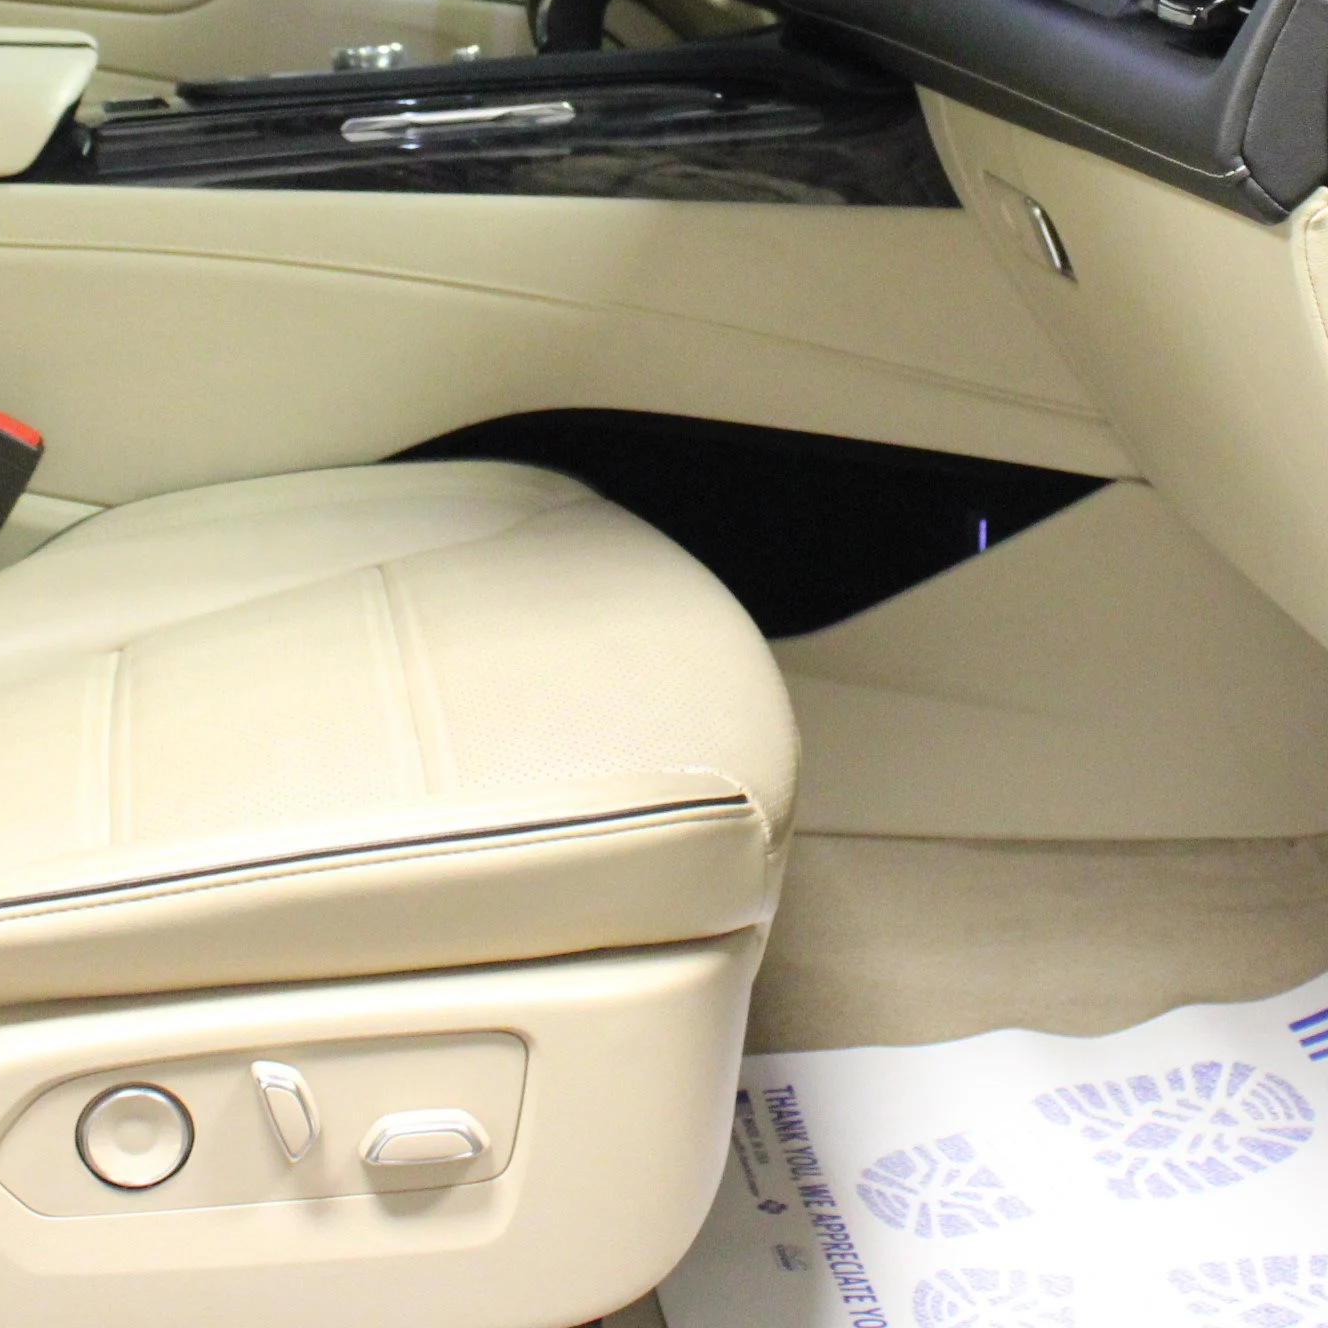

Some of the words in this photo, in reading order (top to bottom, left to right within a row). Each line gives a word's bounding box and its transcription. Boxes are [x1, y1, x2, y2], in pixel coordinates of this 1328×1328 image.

[763, 1083, 810, 1143] THANK
[798, 1183, 836, 1208] WE
[809, 1213, 879, 1304] APPRECIATE
[849, 1307, 888, 1328] YO
